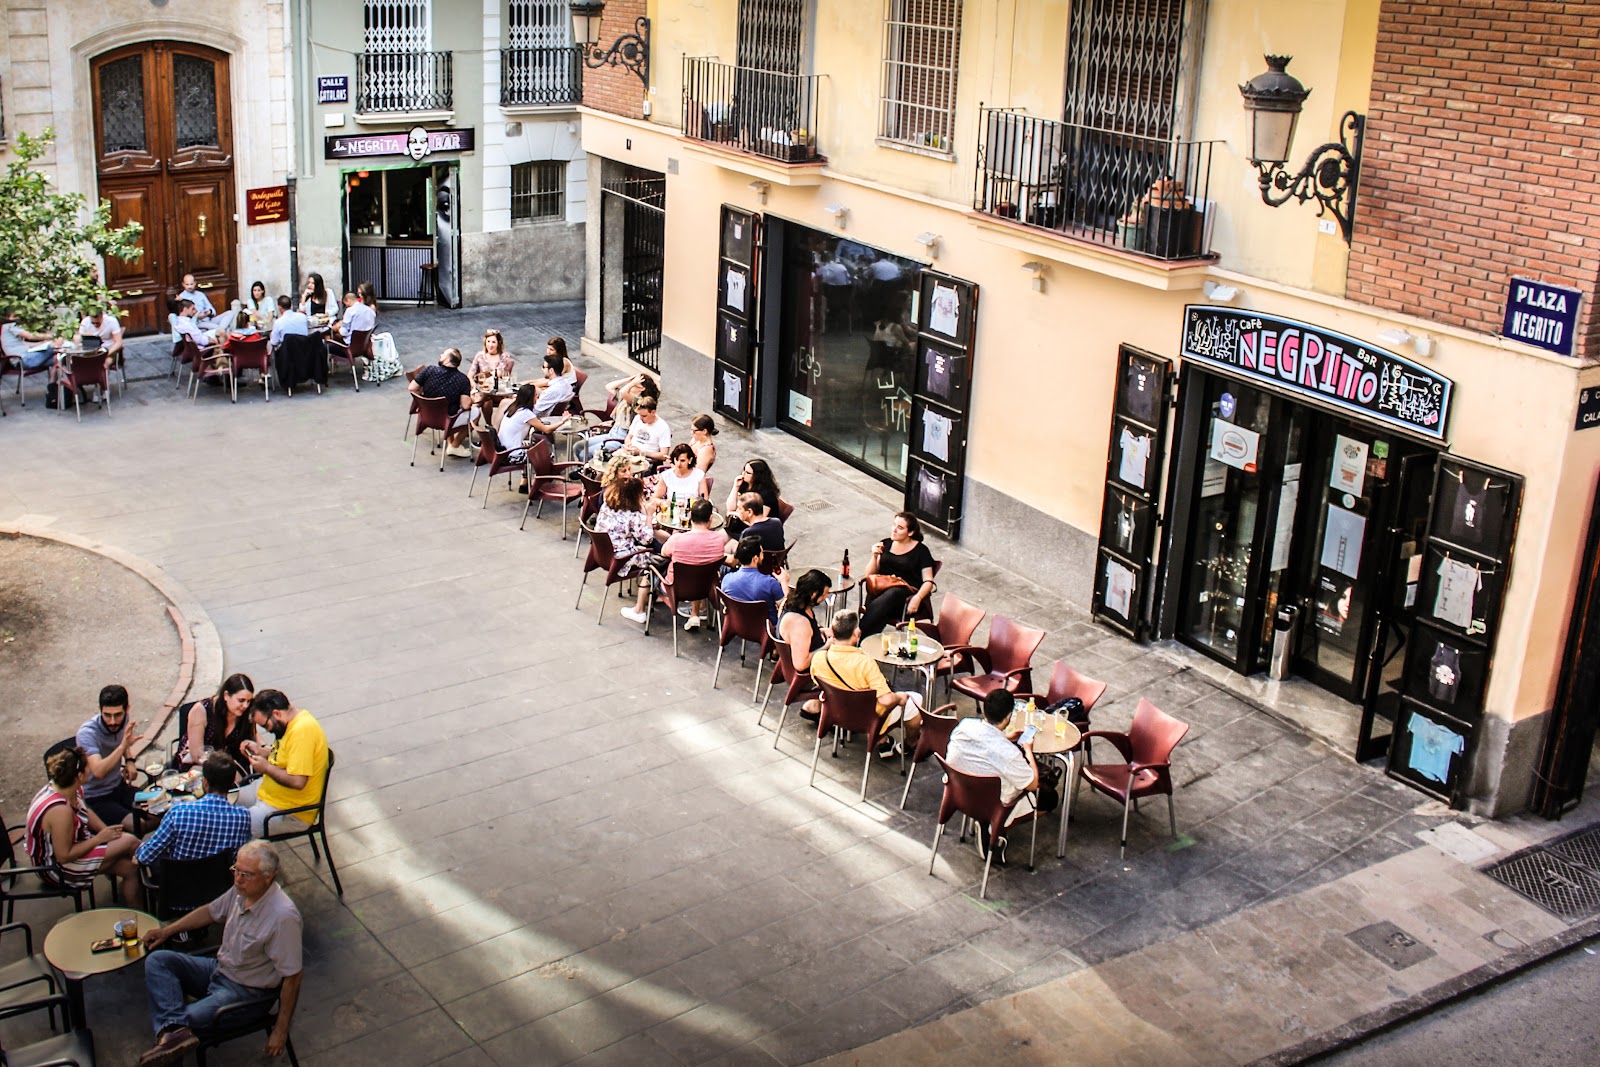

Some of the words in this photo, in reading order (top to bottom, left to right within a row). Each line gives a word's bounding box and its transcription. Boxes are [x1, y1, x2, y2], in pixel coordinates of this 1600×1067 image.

[321, 78, 344, 87] CALLE
[432, 133, 460, 150] BAR
[1516, 284, 1567, 314] PLAZA
[1511, 311, 1564, 346] NEGRITO
